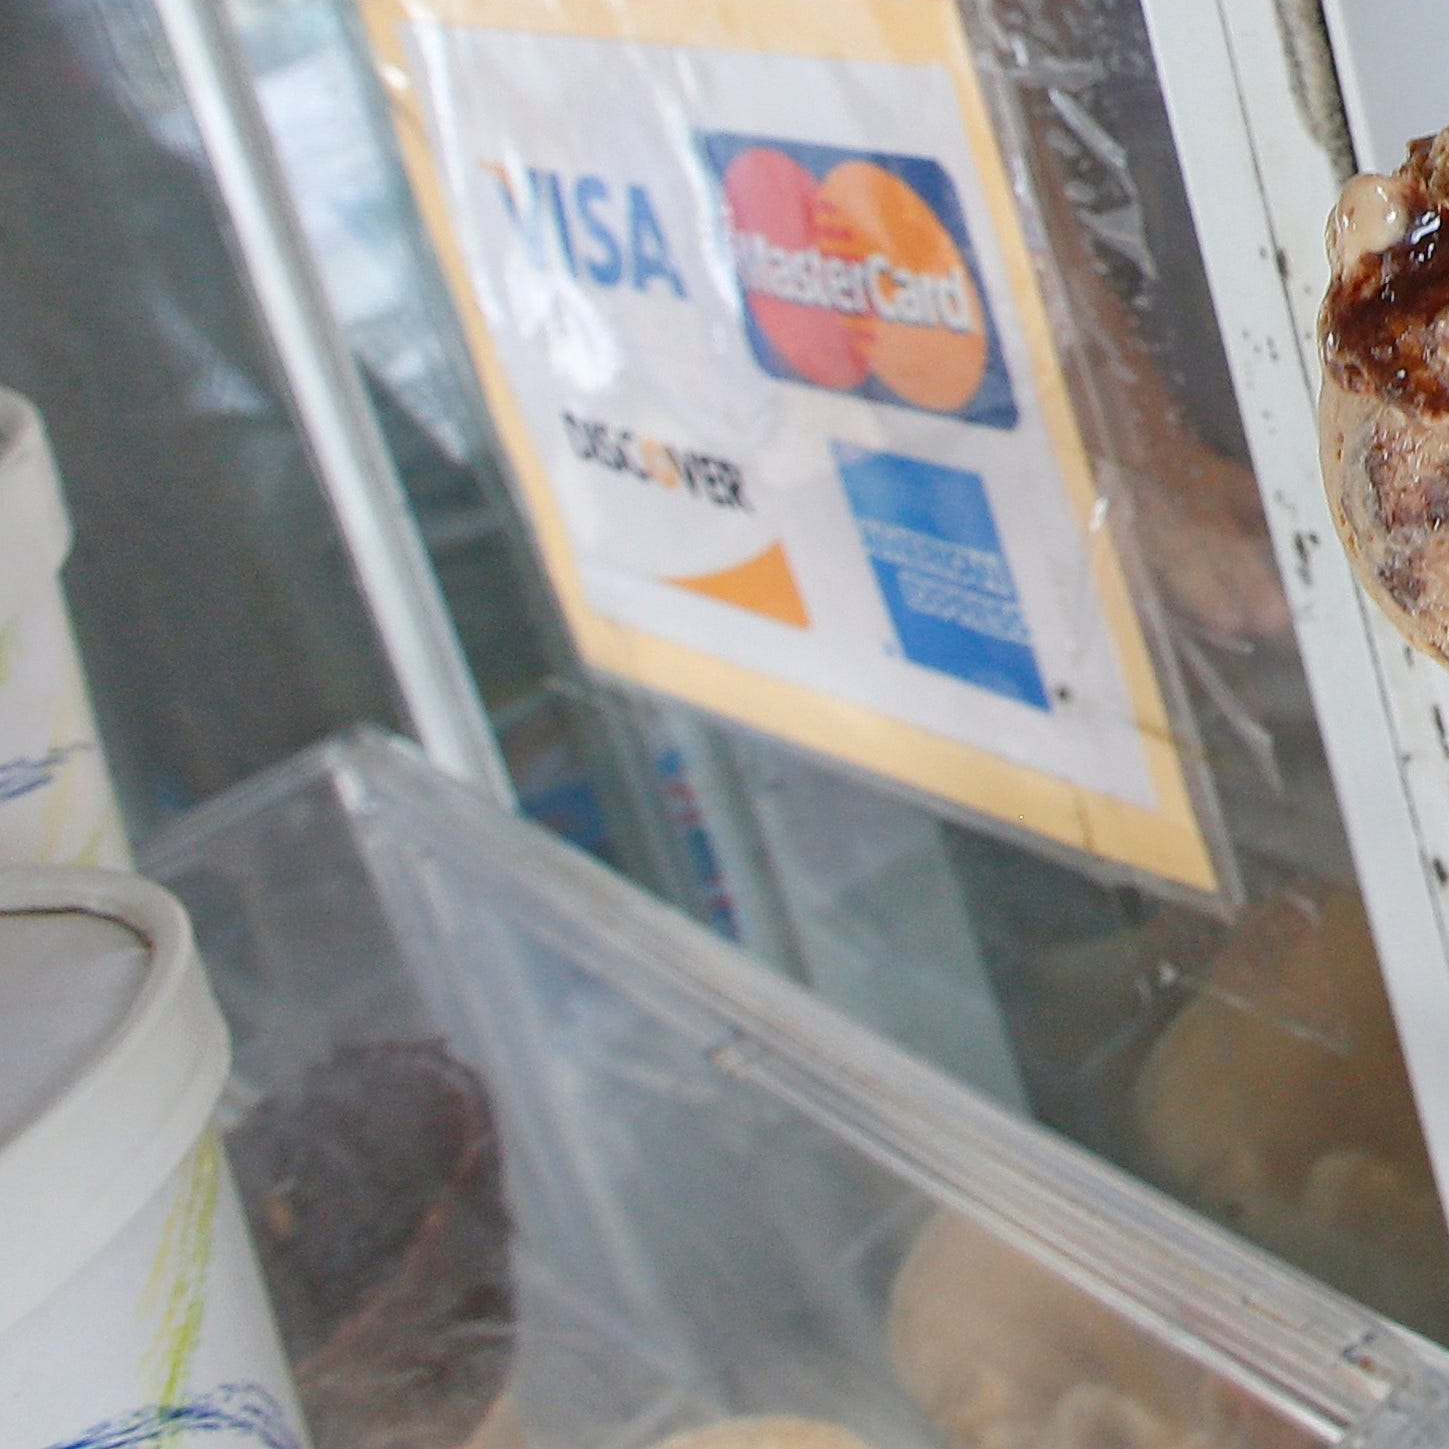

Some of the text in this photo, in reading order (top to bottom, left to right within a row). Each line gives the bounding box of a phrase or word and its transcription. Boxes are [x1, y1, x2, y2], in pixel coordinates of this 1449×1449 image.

[478, 156, 975, 336] VISA MasterCard
[560, 409, 750, 512] DISCOVER
